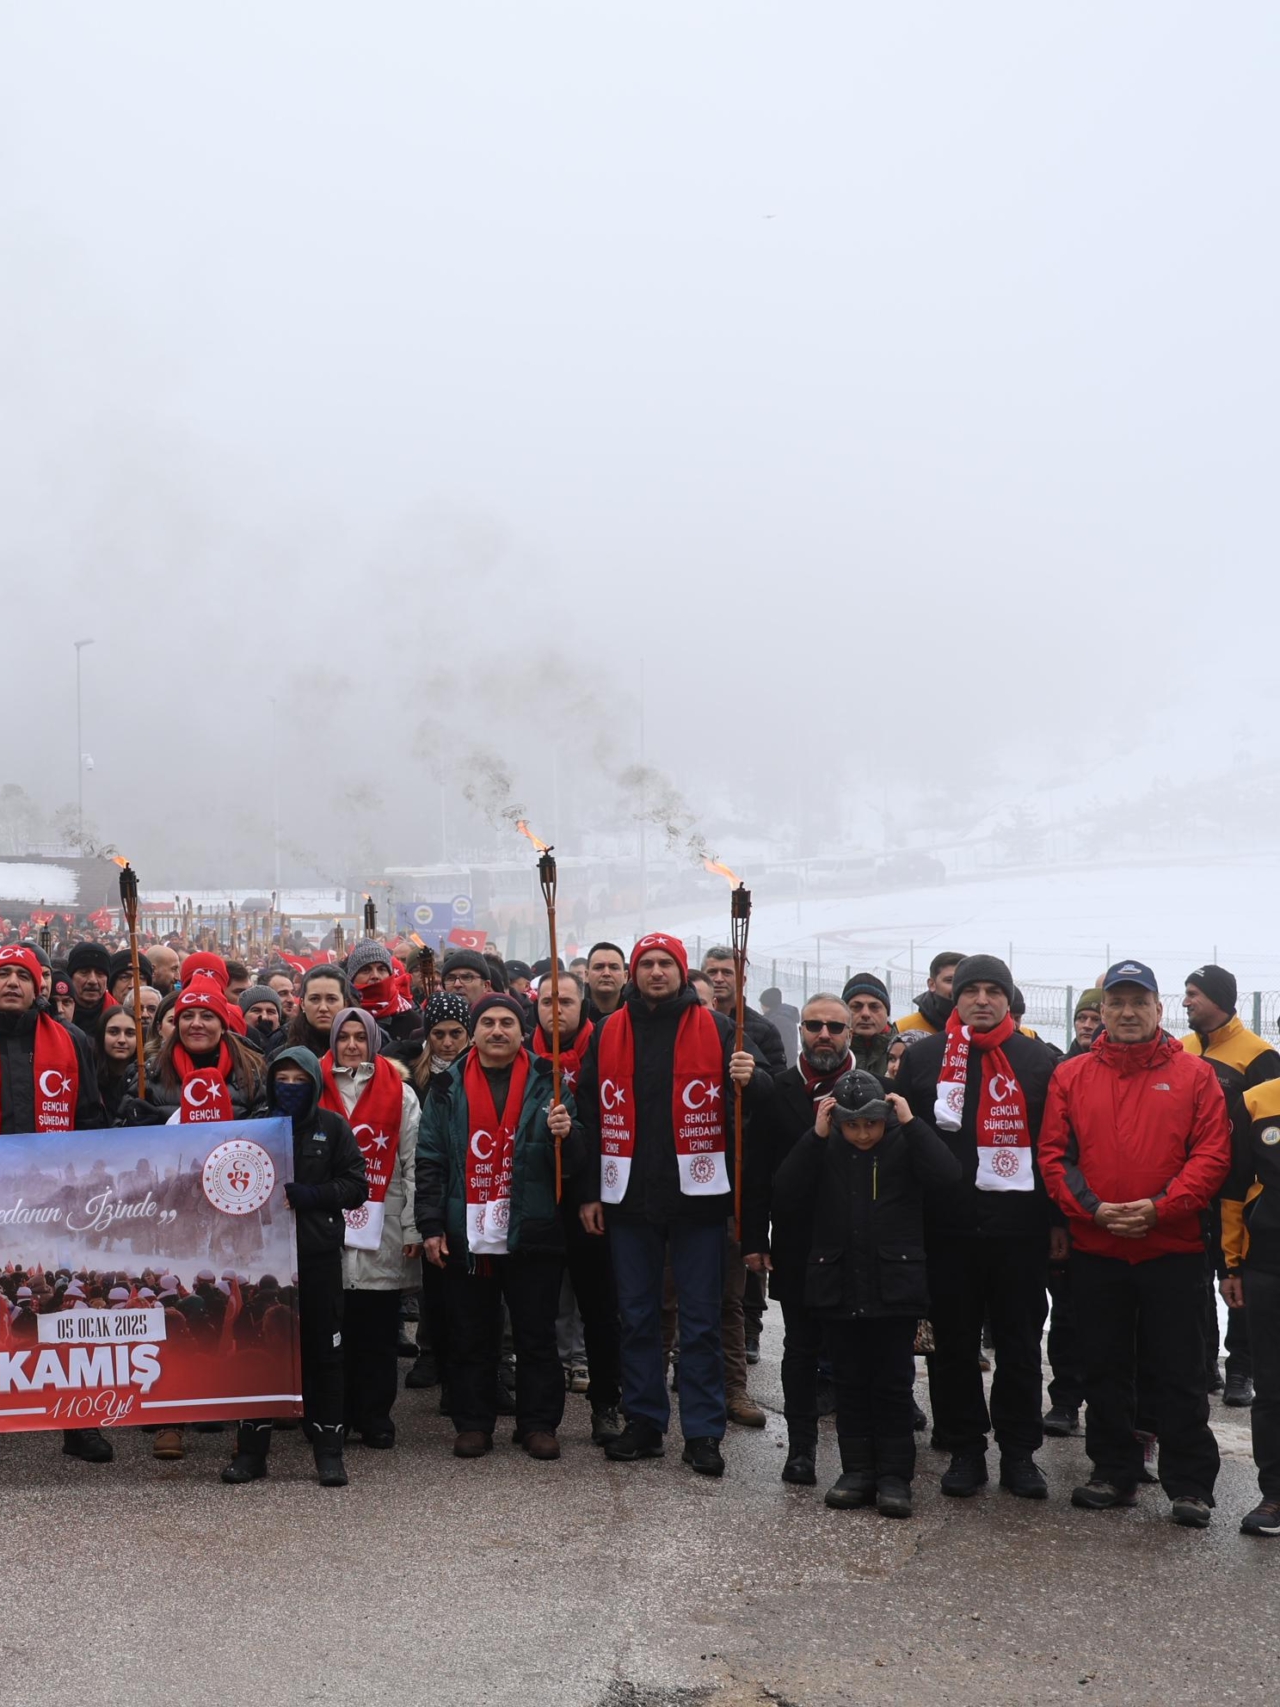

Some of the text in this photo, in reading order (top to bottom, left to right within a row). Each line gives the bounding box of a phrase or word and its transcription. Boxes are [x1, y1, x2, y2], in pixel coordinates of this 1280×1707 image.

[42, 1101, 69, 1112] GENÇLİK
[990, 1104, 1020, 1118] GENÇLİK
[190, 1107, 221, 1121] GENÇLİK
[603, 1113, 624, 1126] GENÇLİK
[684, 1110, 718, 1124] GENÇLİK
[984, 1118, 1025, 1131] ŞÜHEDANIN
[601, 1127, 630, 1140] ŞÜHEDANIN
[679, 1125, 722, 1139] ŞÜHEDANIN
[992, 1132, 1018, 1145] İZİNDE
[605, 1142, 619, 1154] İZİNDE
[689, 1139, 713, 1151] İZİNDE
[57, 1314, 148, 1340] 05 OCAK 2025
